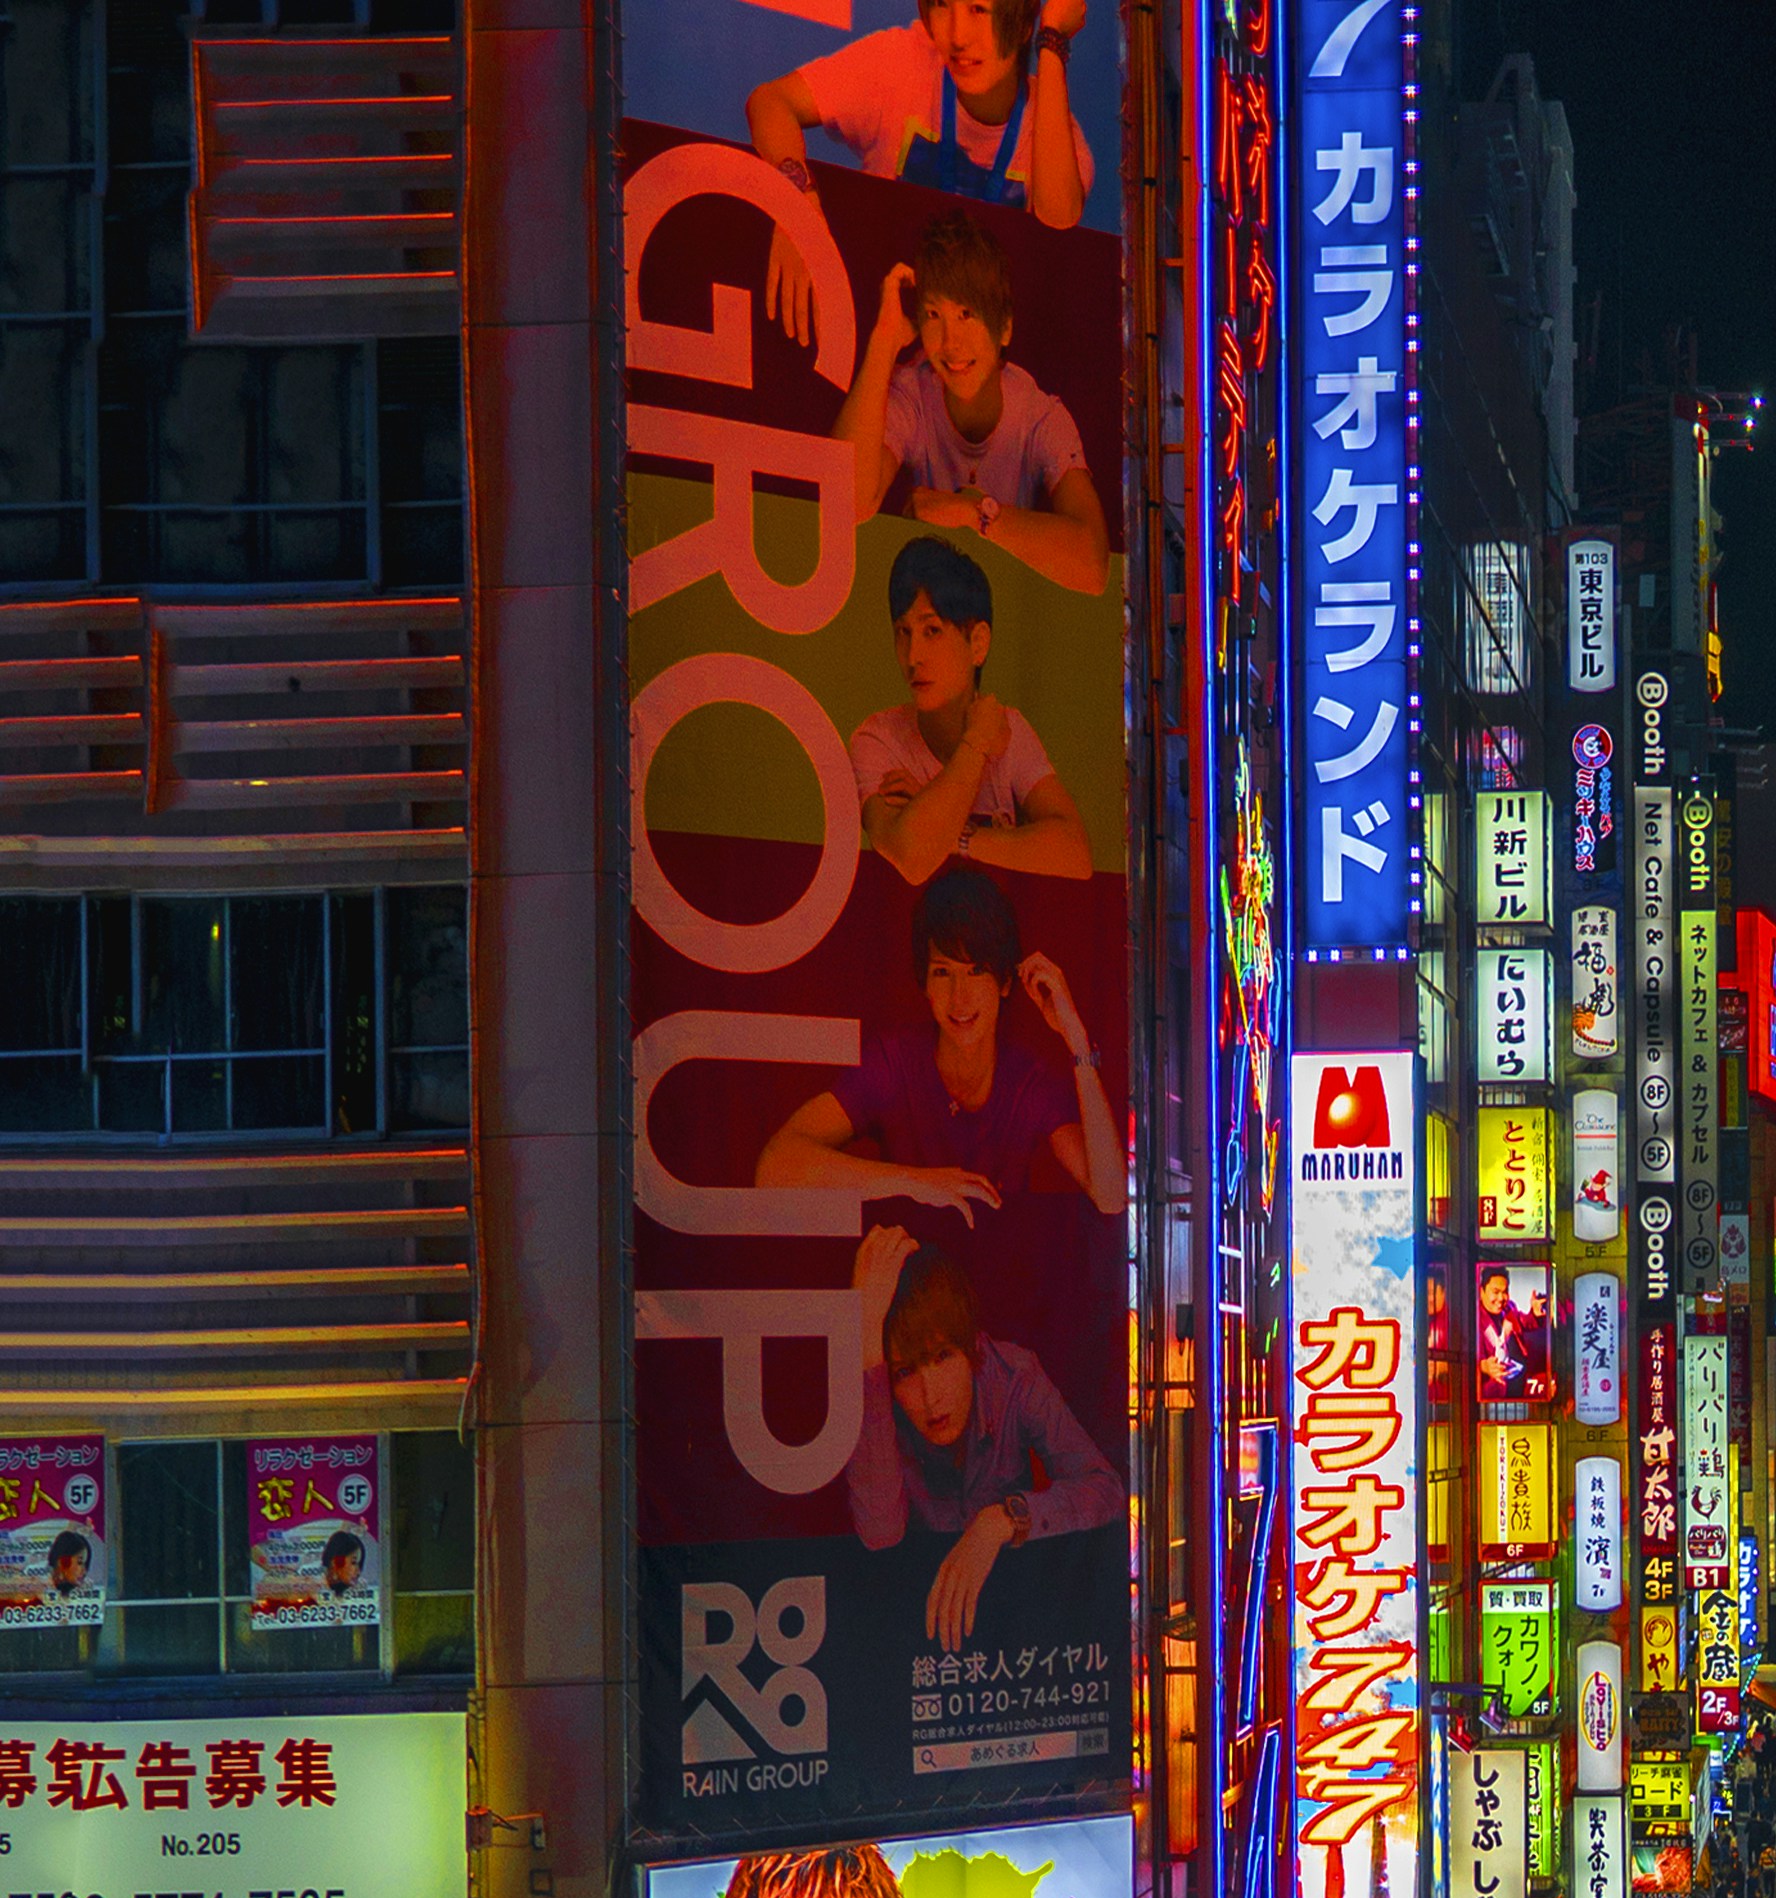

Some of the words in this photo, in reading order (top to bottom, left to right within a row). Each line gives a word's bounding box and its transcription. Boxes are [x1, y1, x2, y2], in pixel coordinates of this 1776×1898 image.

[1312, 131, 1399, 904] カラオケランド
[1580, 569, 1604, 677] 東京ビル
[1637, 672, 1668, 773] Booth
[623, 142, 864, 1496] GROUP
[1644, 803, 1661, 845] Net
[1493, 797, 1527, 918] 川新ビル
[1684, 799, 1712, 890] Booth
[1645, 856, 1662, 918] Cafe
[1646, 929, 1663, 945] &
[1690, 925, 1708, 1047] ネットカフェ
[1497, 955, 1525, 1076] にいむら
[1643, 956, 1667, 1063] Capsule
[1692, 1083, 1709, 1164] カプセル
[1302, 1152, 1402, 1180] MARUHAN
[1503, 1120, 1525, 1230] ととりこ
[1640, 1197, 1671, 1298] Booth
[1582, 1303, 1614, 1369] 楽天屋
[1527, 1379, 1544, 1394] 7F
[1651, 1329, 1664, 1422] 手作り居酒屋
[255, 1445, 372, 1472] リラクゼーション
[71, 1485, 94, 1504] 5F
[345, 1485, 368, 1504] 5F
[1640, 1426, 1675, 1541] 甘太郎
[1507, 1544, 1523, 1556] 6F
[1645, 1558, 1673, 1578] 4F
[1299, 1306, 1415, 1847] カラオケ747
[1645, 1580, 1672, 1599] 3F
[1694, 1568, 1718, 1586] B1
[4, 1604, 99, 1624] 03-6233-7662
[278, 1603, 376, 1624] 03-6233-7662
[1489, 1591, 1542, 1607] 質・買取
[1702, 1591, 1738, 1682] 金の蔵
[911, 1642, 1109, 1689] 総合求人ダイヤル
[949, 1681, 1108, 1715] 0120-744-921
[1532, 1701, 1549, 1714] 5F
[1703, 1691, 1726, 1713] 2F
[683, 1769, 737, 1797] RAIN
[747, 1760, 828, 1791] GROUP
[1631, 1766, 1683, 1779] リーチ麻雀
[1631, 1781, 1683, 1801] ロード
[162, 1833, 240, 1856] No.205
